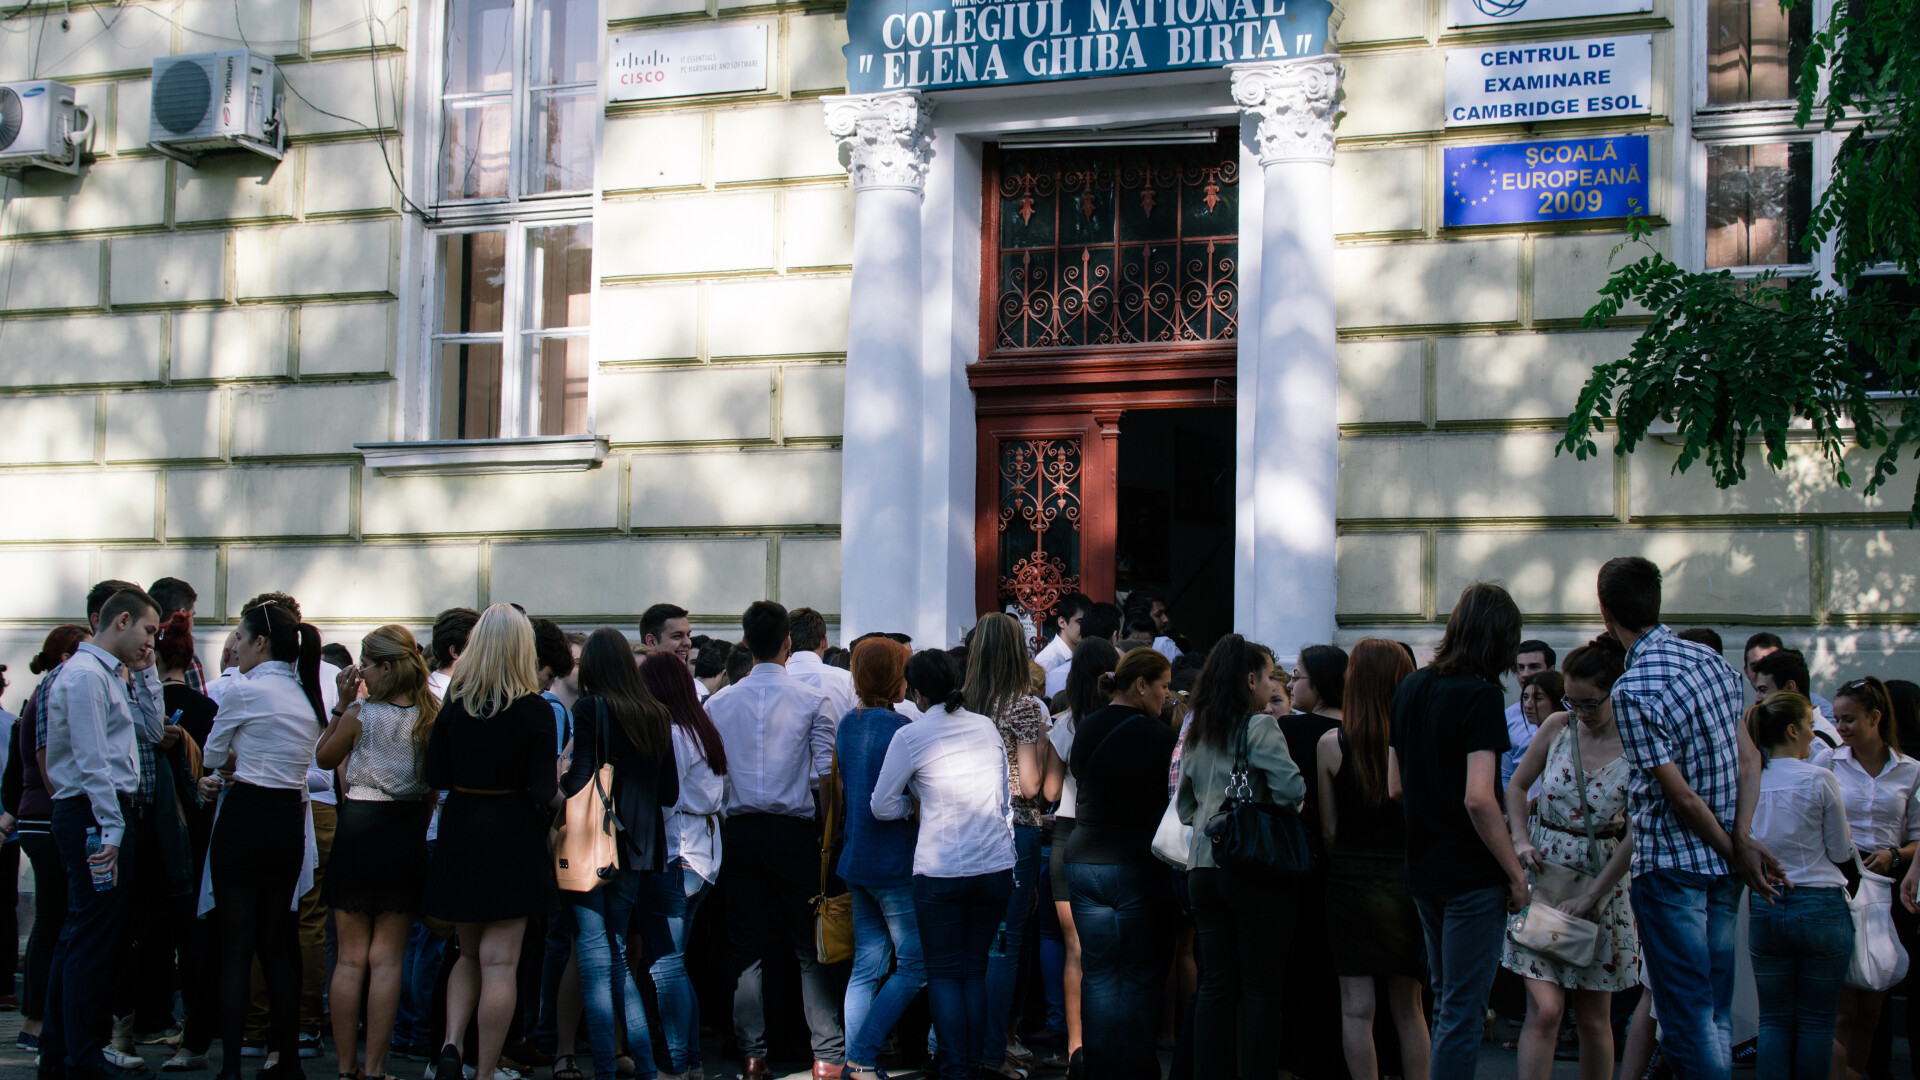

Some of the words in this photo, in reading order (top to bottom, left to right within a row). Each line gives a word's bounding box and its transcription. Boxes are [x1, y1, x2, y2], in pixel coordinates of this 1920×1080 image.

[882, 0, 1072, 49] COLEGIUL
[1023, 31, 1148, 77] GHIBA
[1480, 46, 1580, 67] CENTRUL
[1587, 42, 1616, 59] DE
[224, 56, 233, 104] Platinium
[621, 70, 665, 85] CISCO
[1484, 69, 1611, 93] EXAMINARE
[1452, 98, 1580, 121] CAMBRIDGE
[1587, 94, 1643, 112] ESOL
[1502, 163, 1641, 191] EUROPEANĂ
[1538, 190, 1603, 214] 2009
